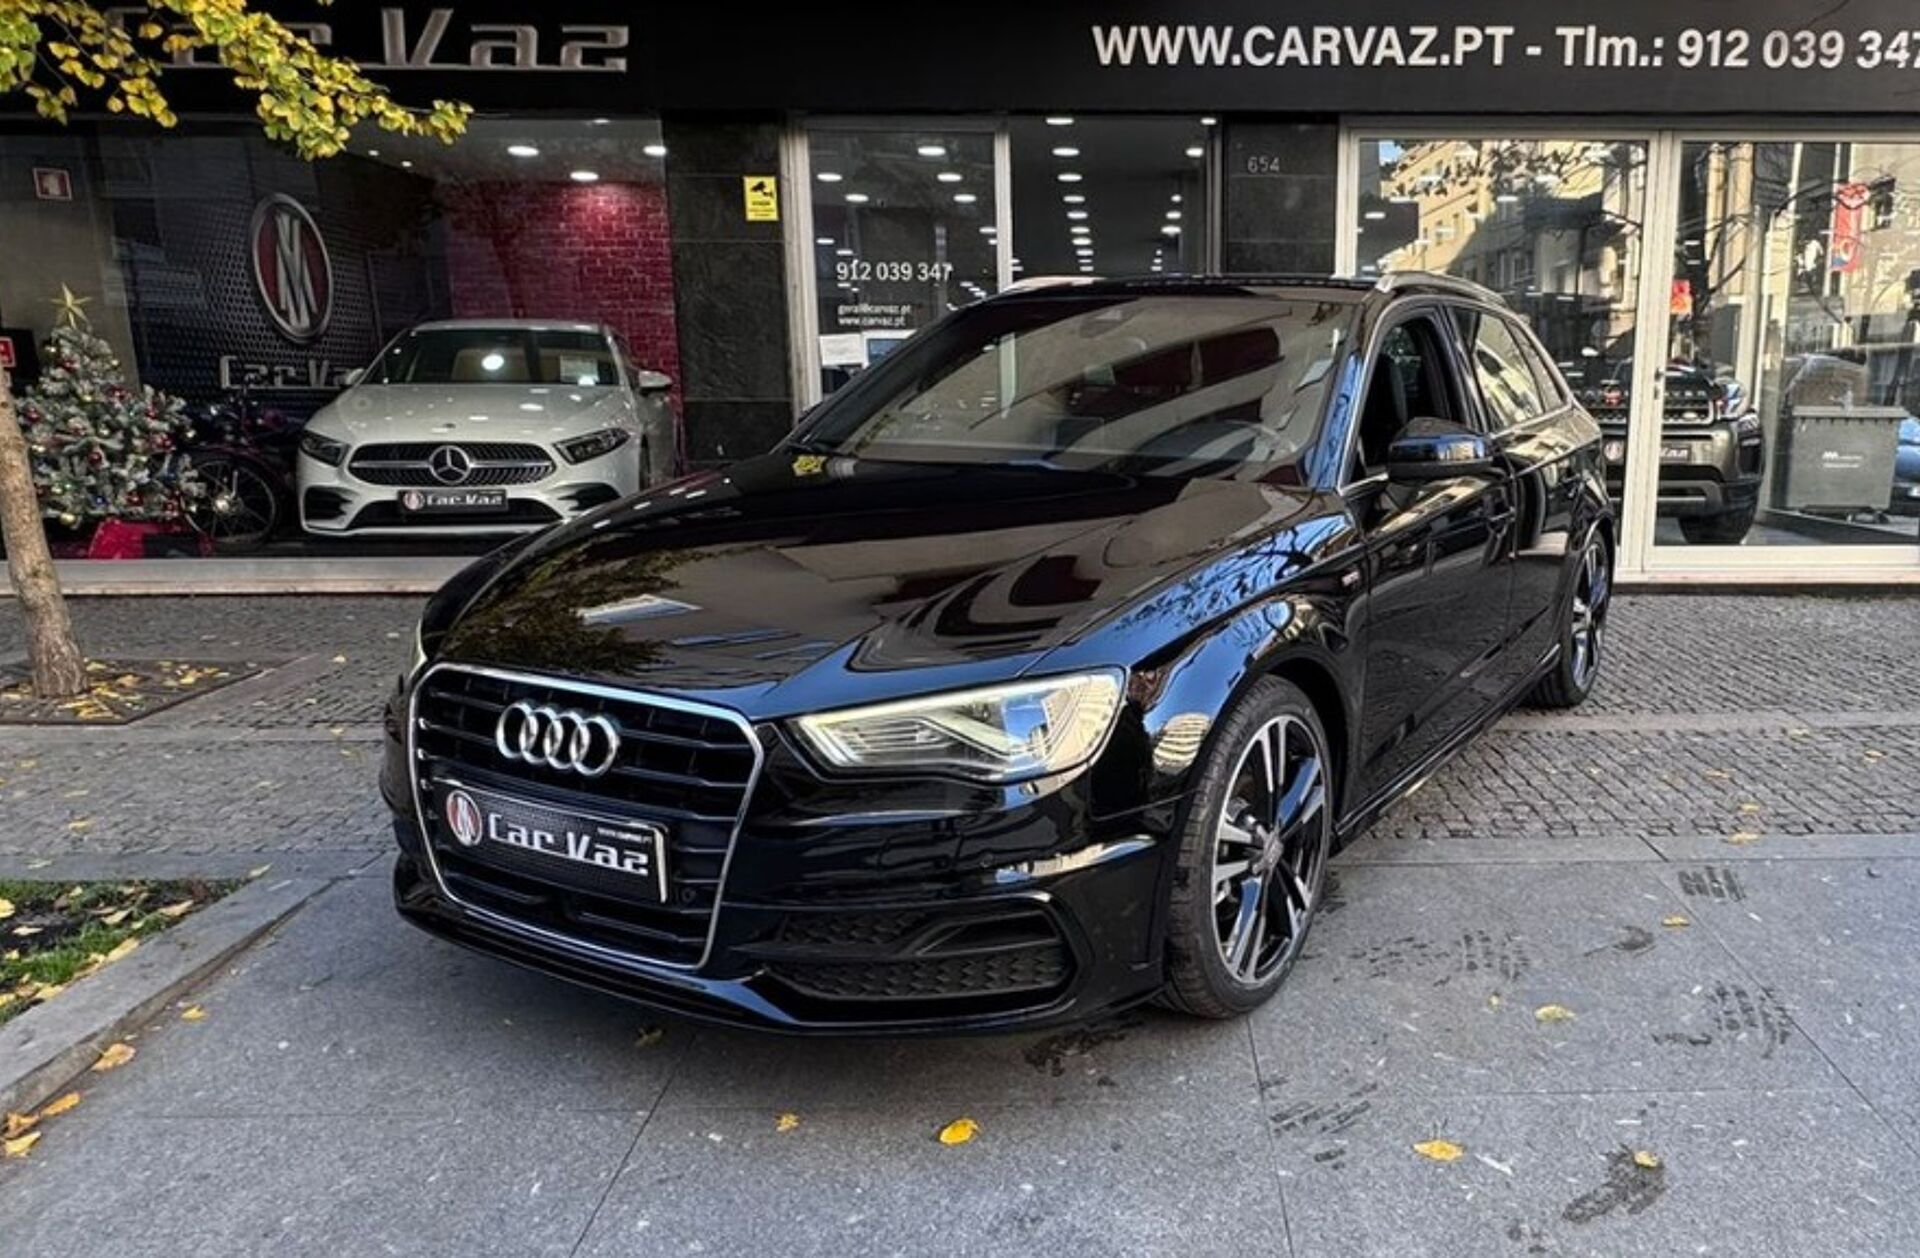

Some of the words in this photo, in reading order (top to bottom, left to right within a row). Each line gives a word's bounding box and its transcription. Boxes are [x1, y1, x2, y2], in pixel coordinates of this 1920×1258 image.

[382, 8, 629, 72] Vaz
[1092, 25, 1514, 66] WWW.CARVAZ.PT
[1555, 25, 1664, 67] Tlm.:
[1677, 28, 1750, 68] 912
[1762, 29, 1845, 69] 039
[1248, 156, 1280, 173] 654
[836, 261, 871, 281] 912
[876, 261, 913, 281] 039
[917, 261, 951, 281] 347
[488, 812, 555, 850] Car
[566, 830, 648, 876] Vaz
